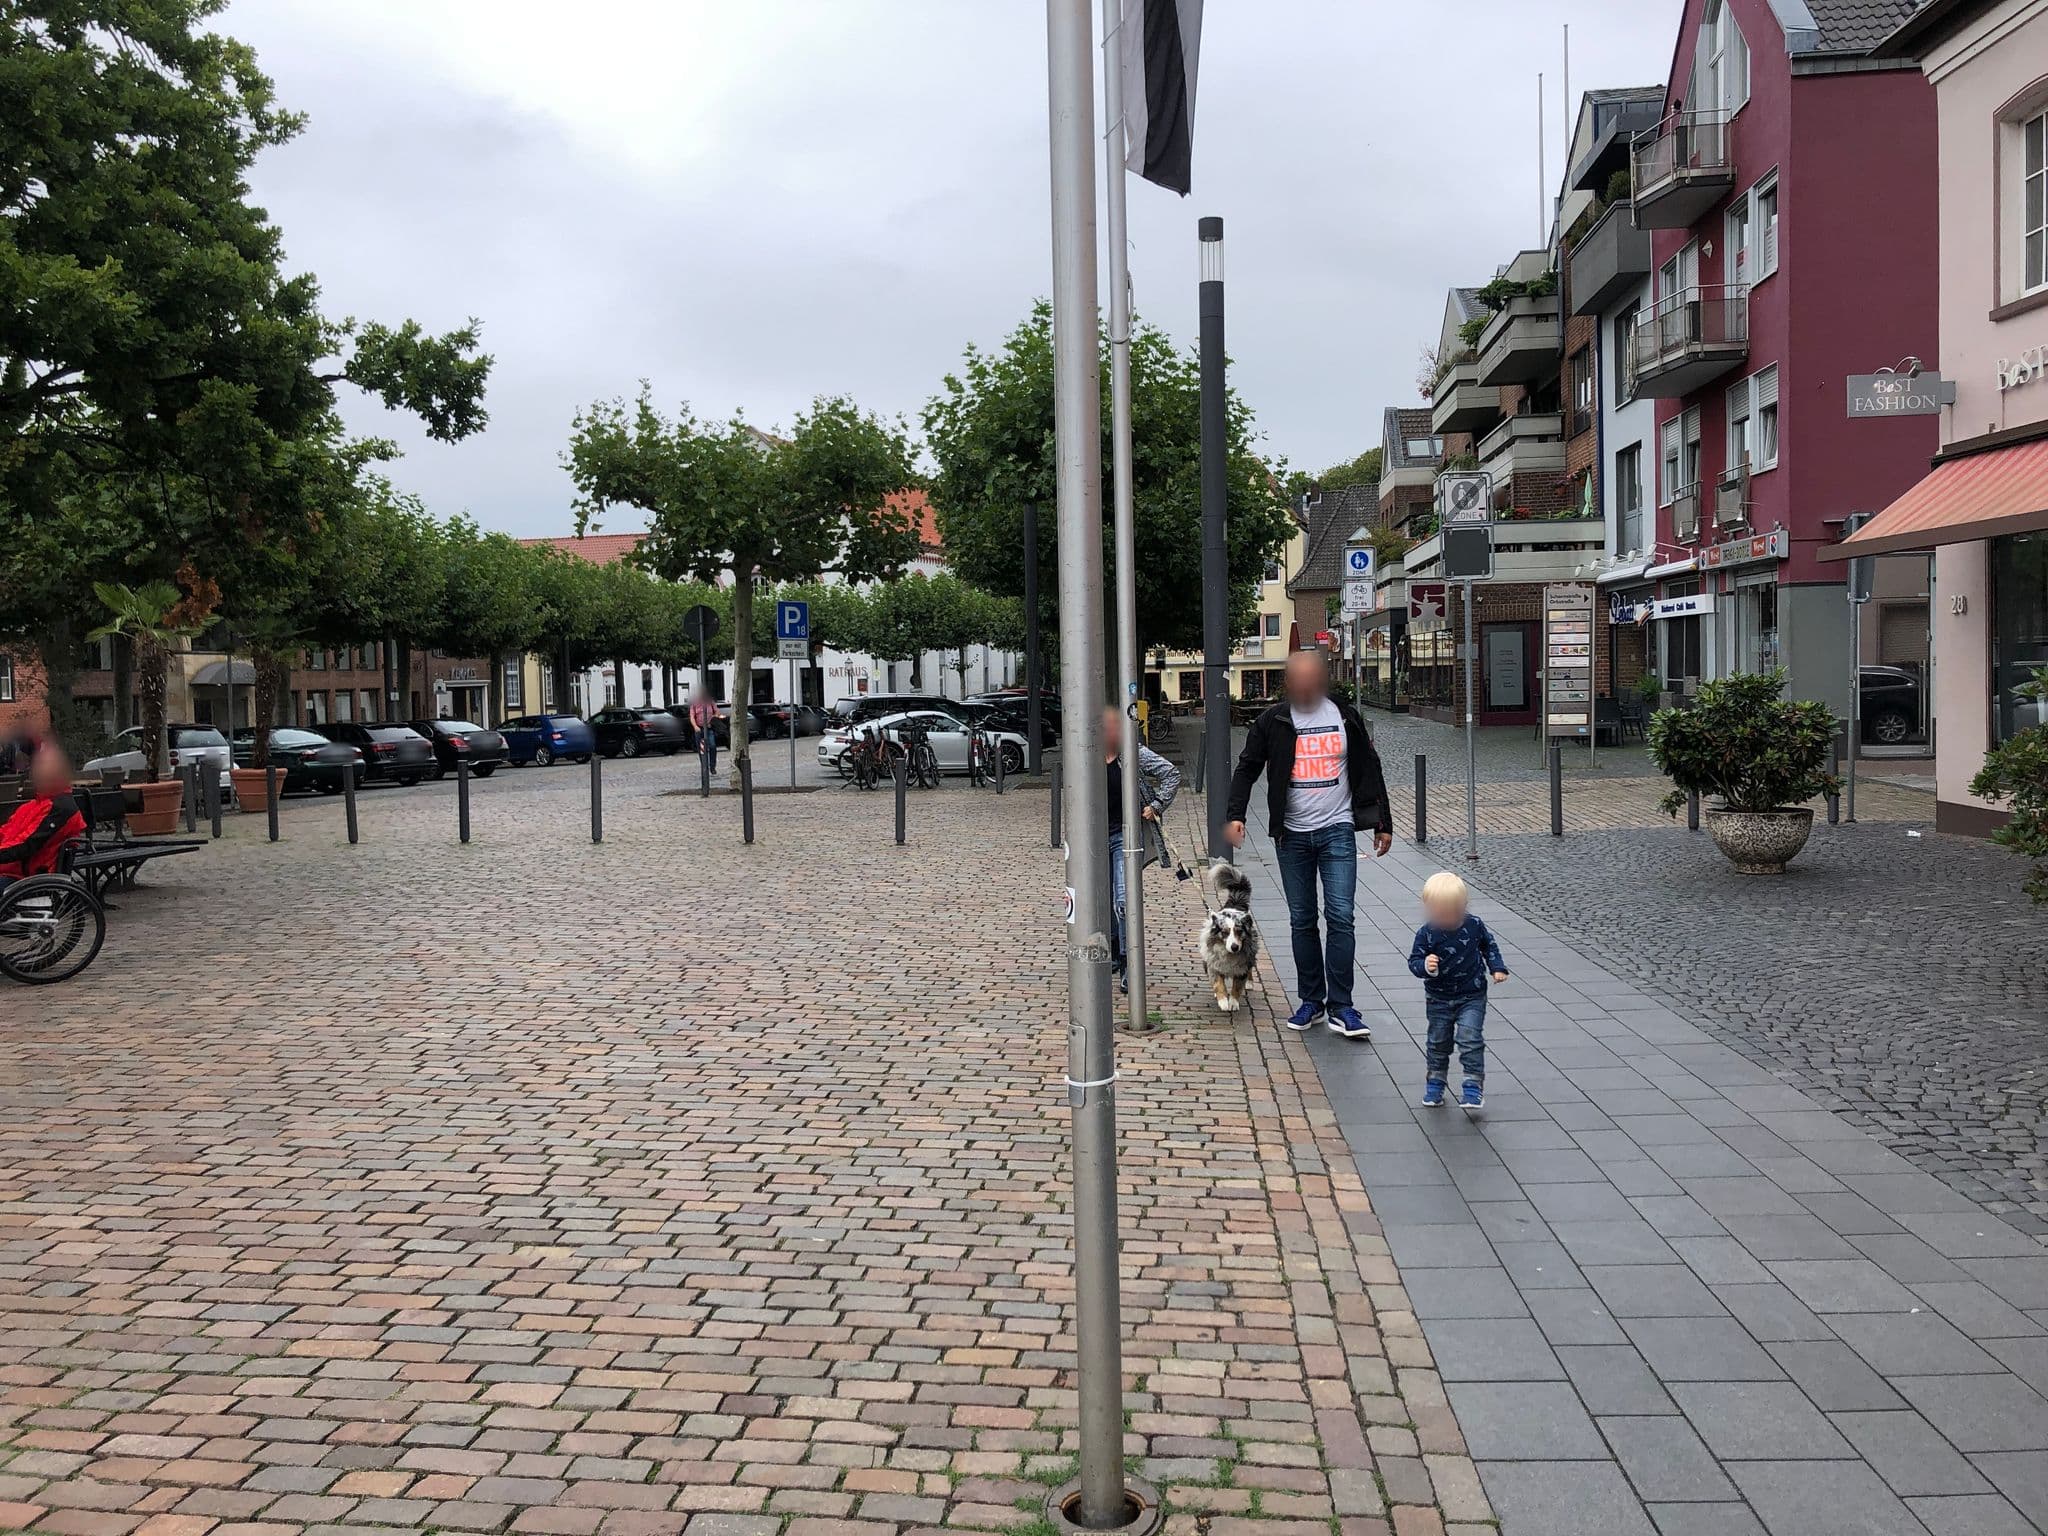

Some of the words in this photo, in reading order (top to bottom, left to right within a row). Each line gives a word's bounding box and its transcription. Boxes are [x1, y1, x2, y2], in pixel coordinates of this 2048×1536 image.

[1855, 394, 1937, 412] FASHION
[784, 606, 801, 634] P
[797, 625, 807, 636] 18
[1291, 757, 1341, 779] ONES
